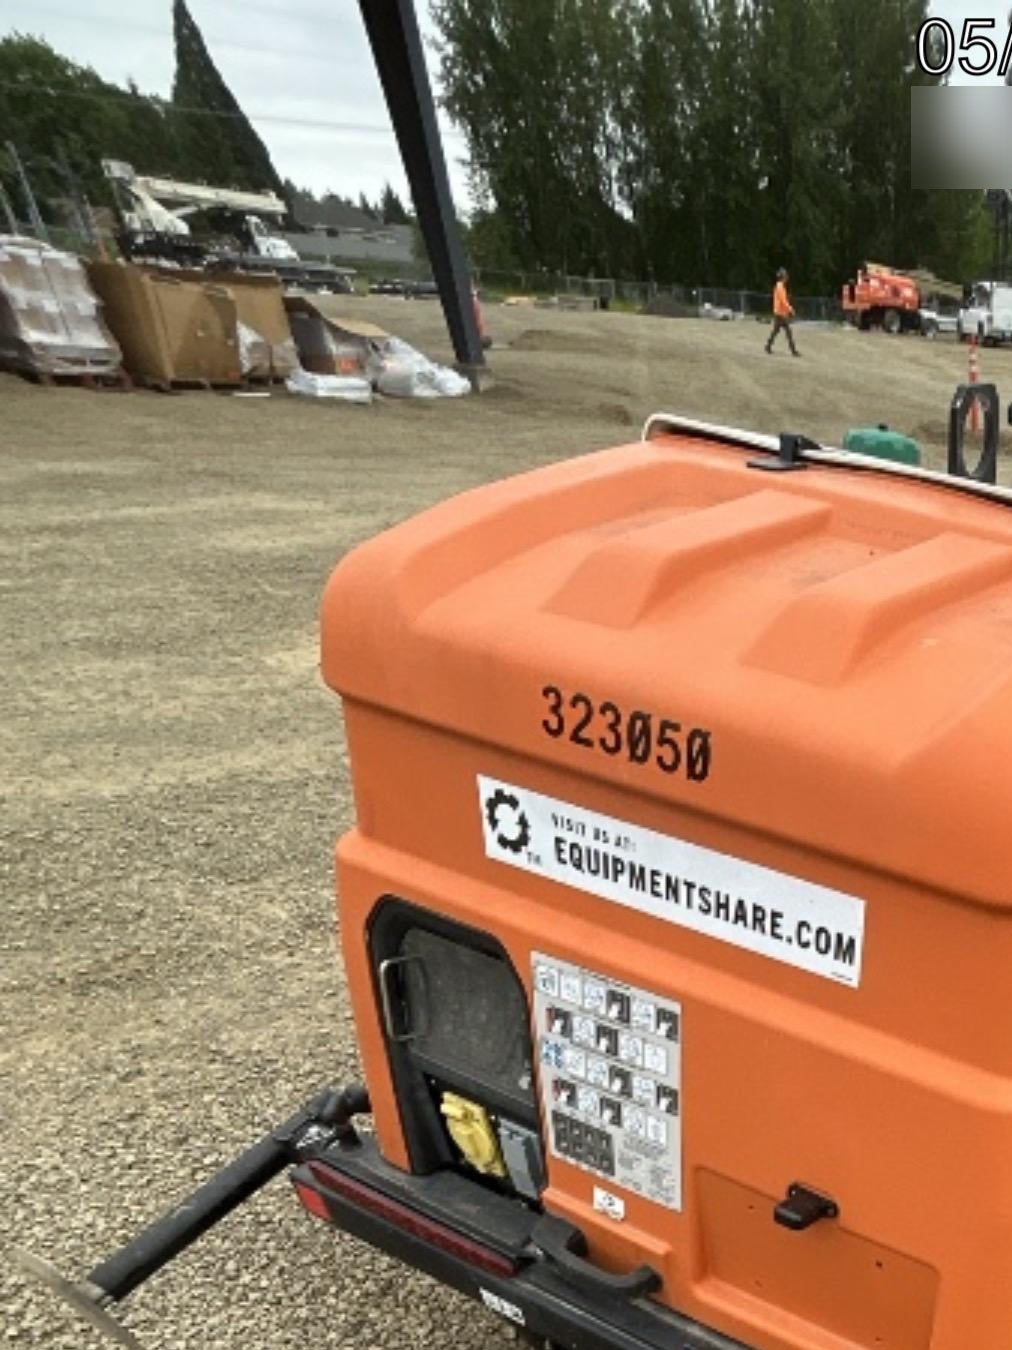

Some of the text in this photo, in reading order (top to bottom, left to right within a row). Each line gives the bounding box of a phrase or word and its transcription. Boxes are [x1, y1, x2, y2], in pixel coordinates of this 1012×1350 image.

[541, 686, 712, 783] 323050
[551, 812, 586, 837] VISIT
[553, 837, 856, 967] EQUIPMENTSHARE.COM
